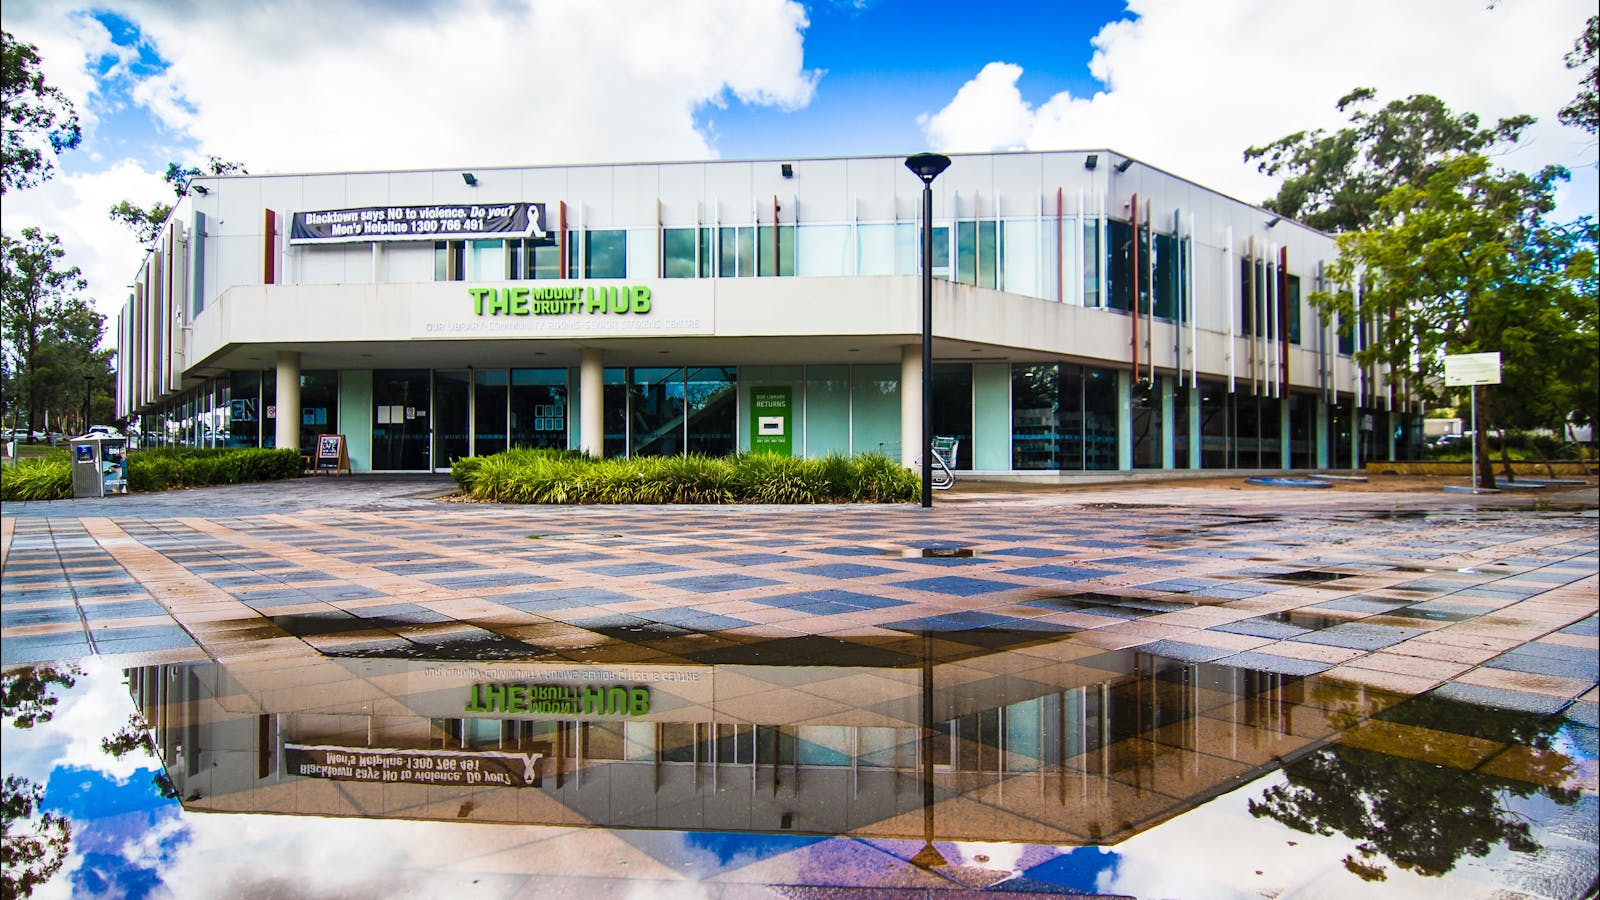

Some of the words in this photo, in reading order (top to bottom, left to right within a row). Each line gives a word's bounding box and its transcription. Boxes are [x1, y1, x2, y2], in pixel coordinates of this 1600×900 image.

[305, 211, 359, 224] Blacktown
[361, 209, 385, 222] says
[387, 208, 403, 220] NO
[405, 208, 417, 219] to
[419, 207, 467, 219] violence.
[470, 206, 486, 217] Do
[487, 205, 515, 219] you?
[331, 223, 361, 236] Men's
[364, 221, 408, 235] Helpline
[410, 220, 437, 232] 1300
[441, 220, 461, 231] 766
[463, 219, 484, 231] 491
[468, 287, 529, 315] THE
[531, 287, 584, 300] MOUNT
[586, 285, 652, 314] HUB
[531, 300, 584, 315] DRUITT
[426, 323, 445, 332] OUR
